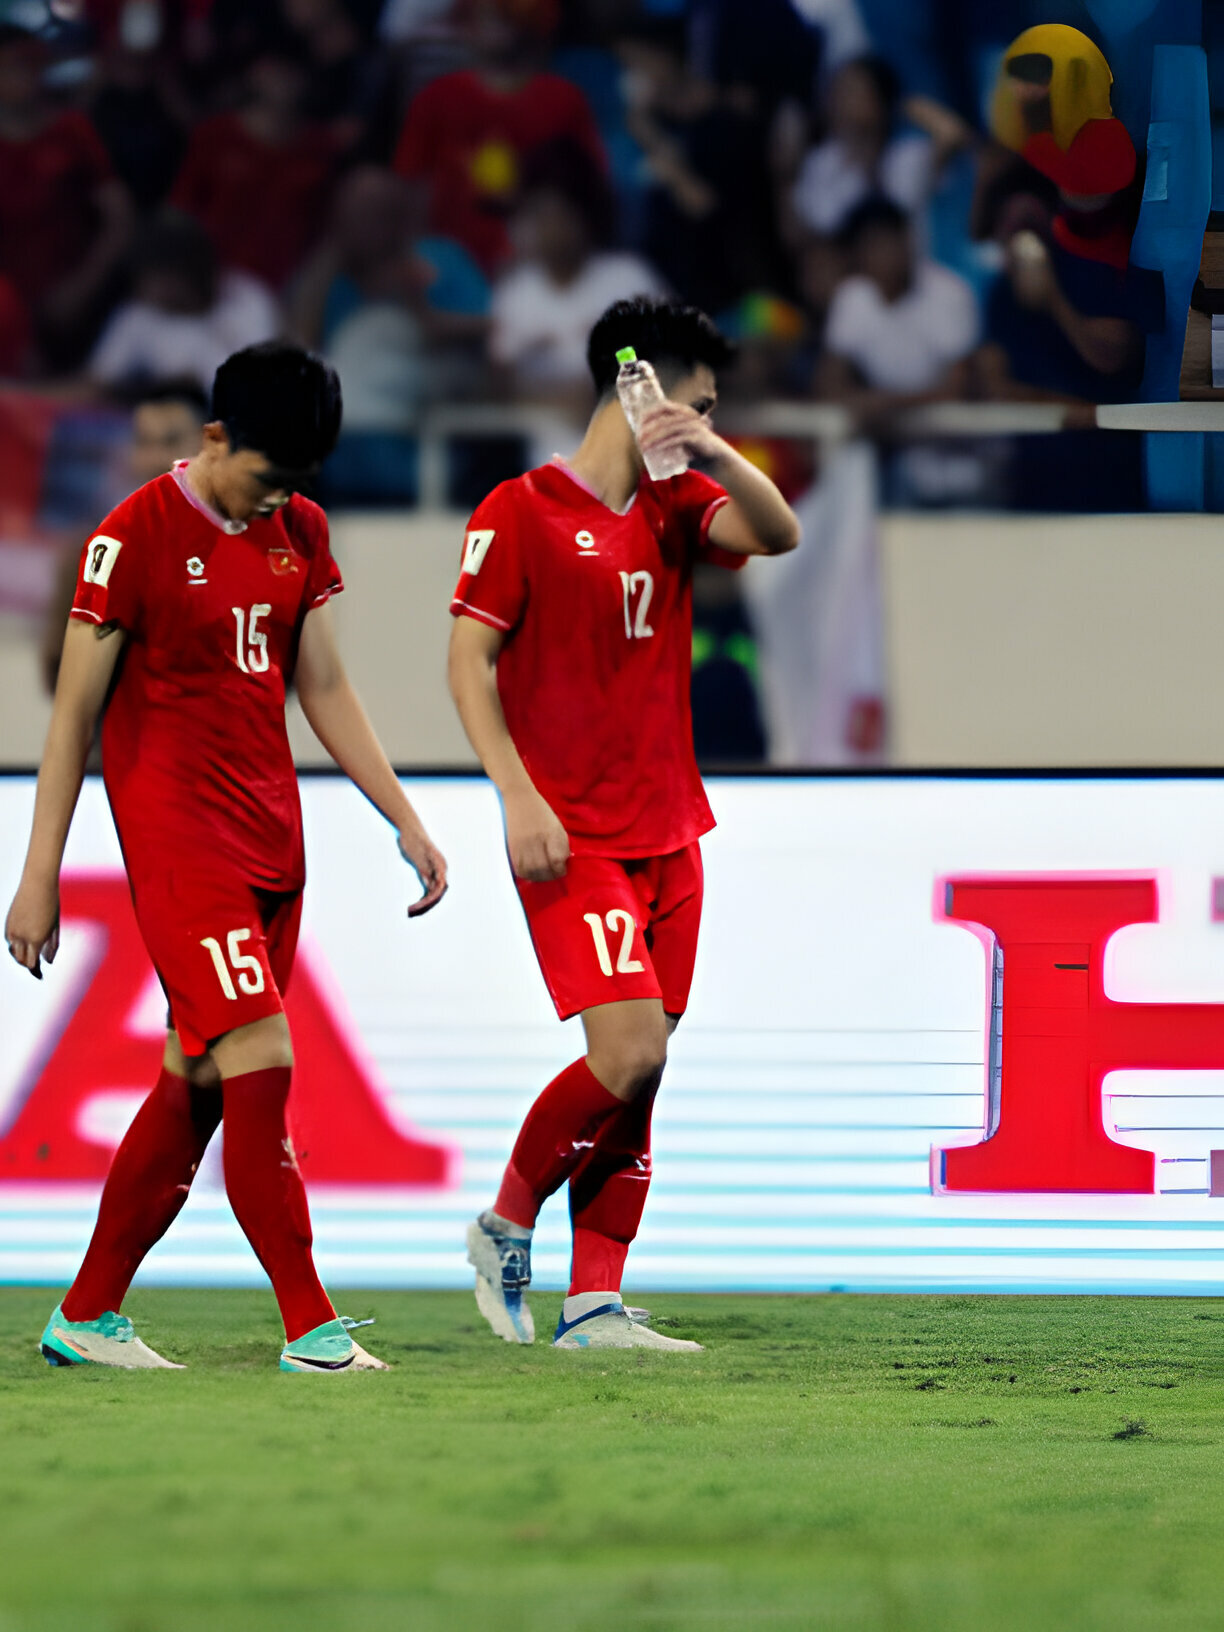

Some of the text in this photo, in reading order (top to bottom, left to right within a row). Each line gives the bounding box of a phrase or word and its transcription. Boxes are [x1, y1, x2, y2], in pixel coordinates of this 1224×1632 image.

[232, 603, 271, 673] 15
[618, 570, 654, 639] 12
[201, 928, 264, 1000] 15
[583, 909, 645, 976] 12
